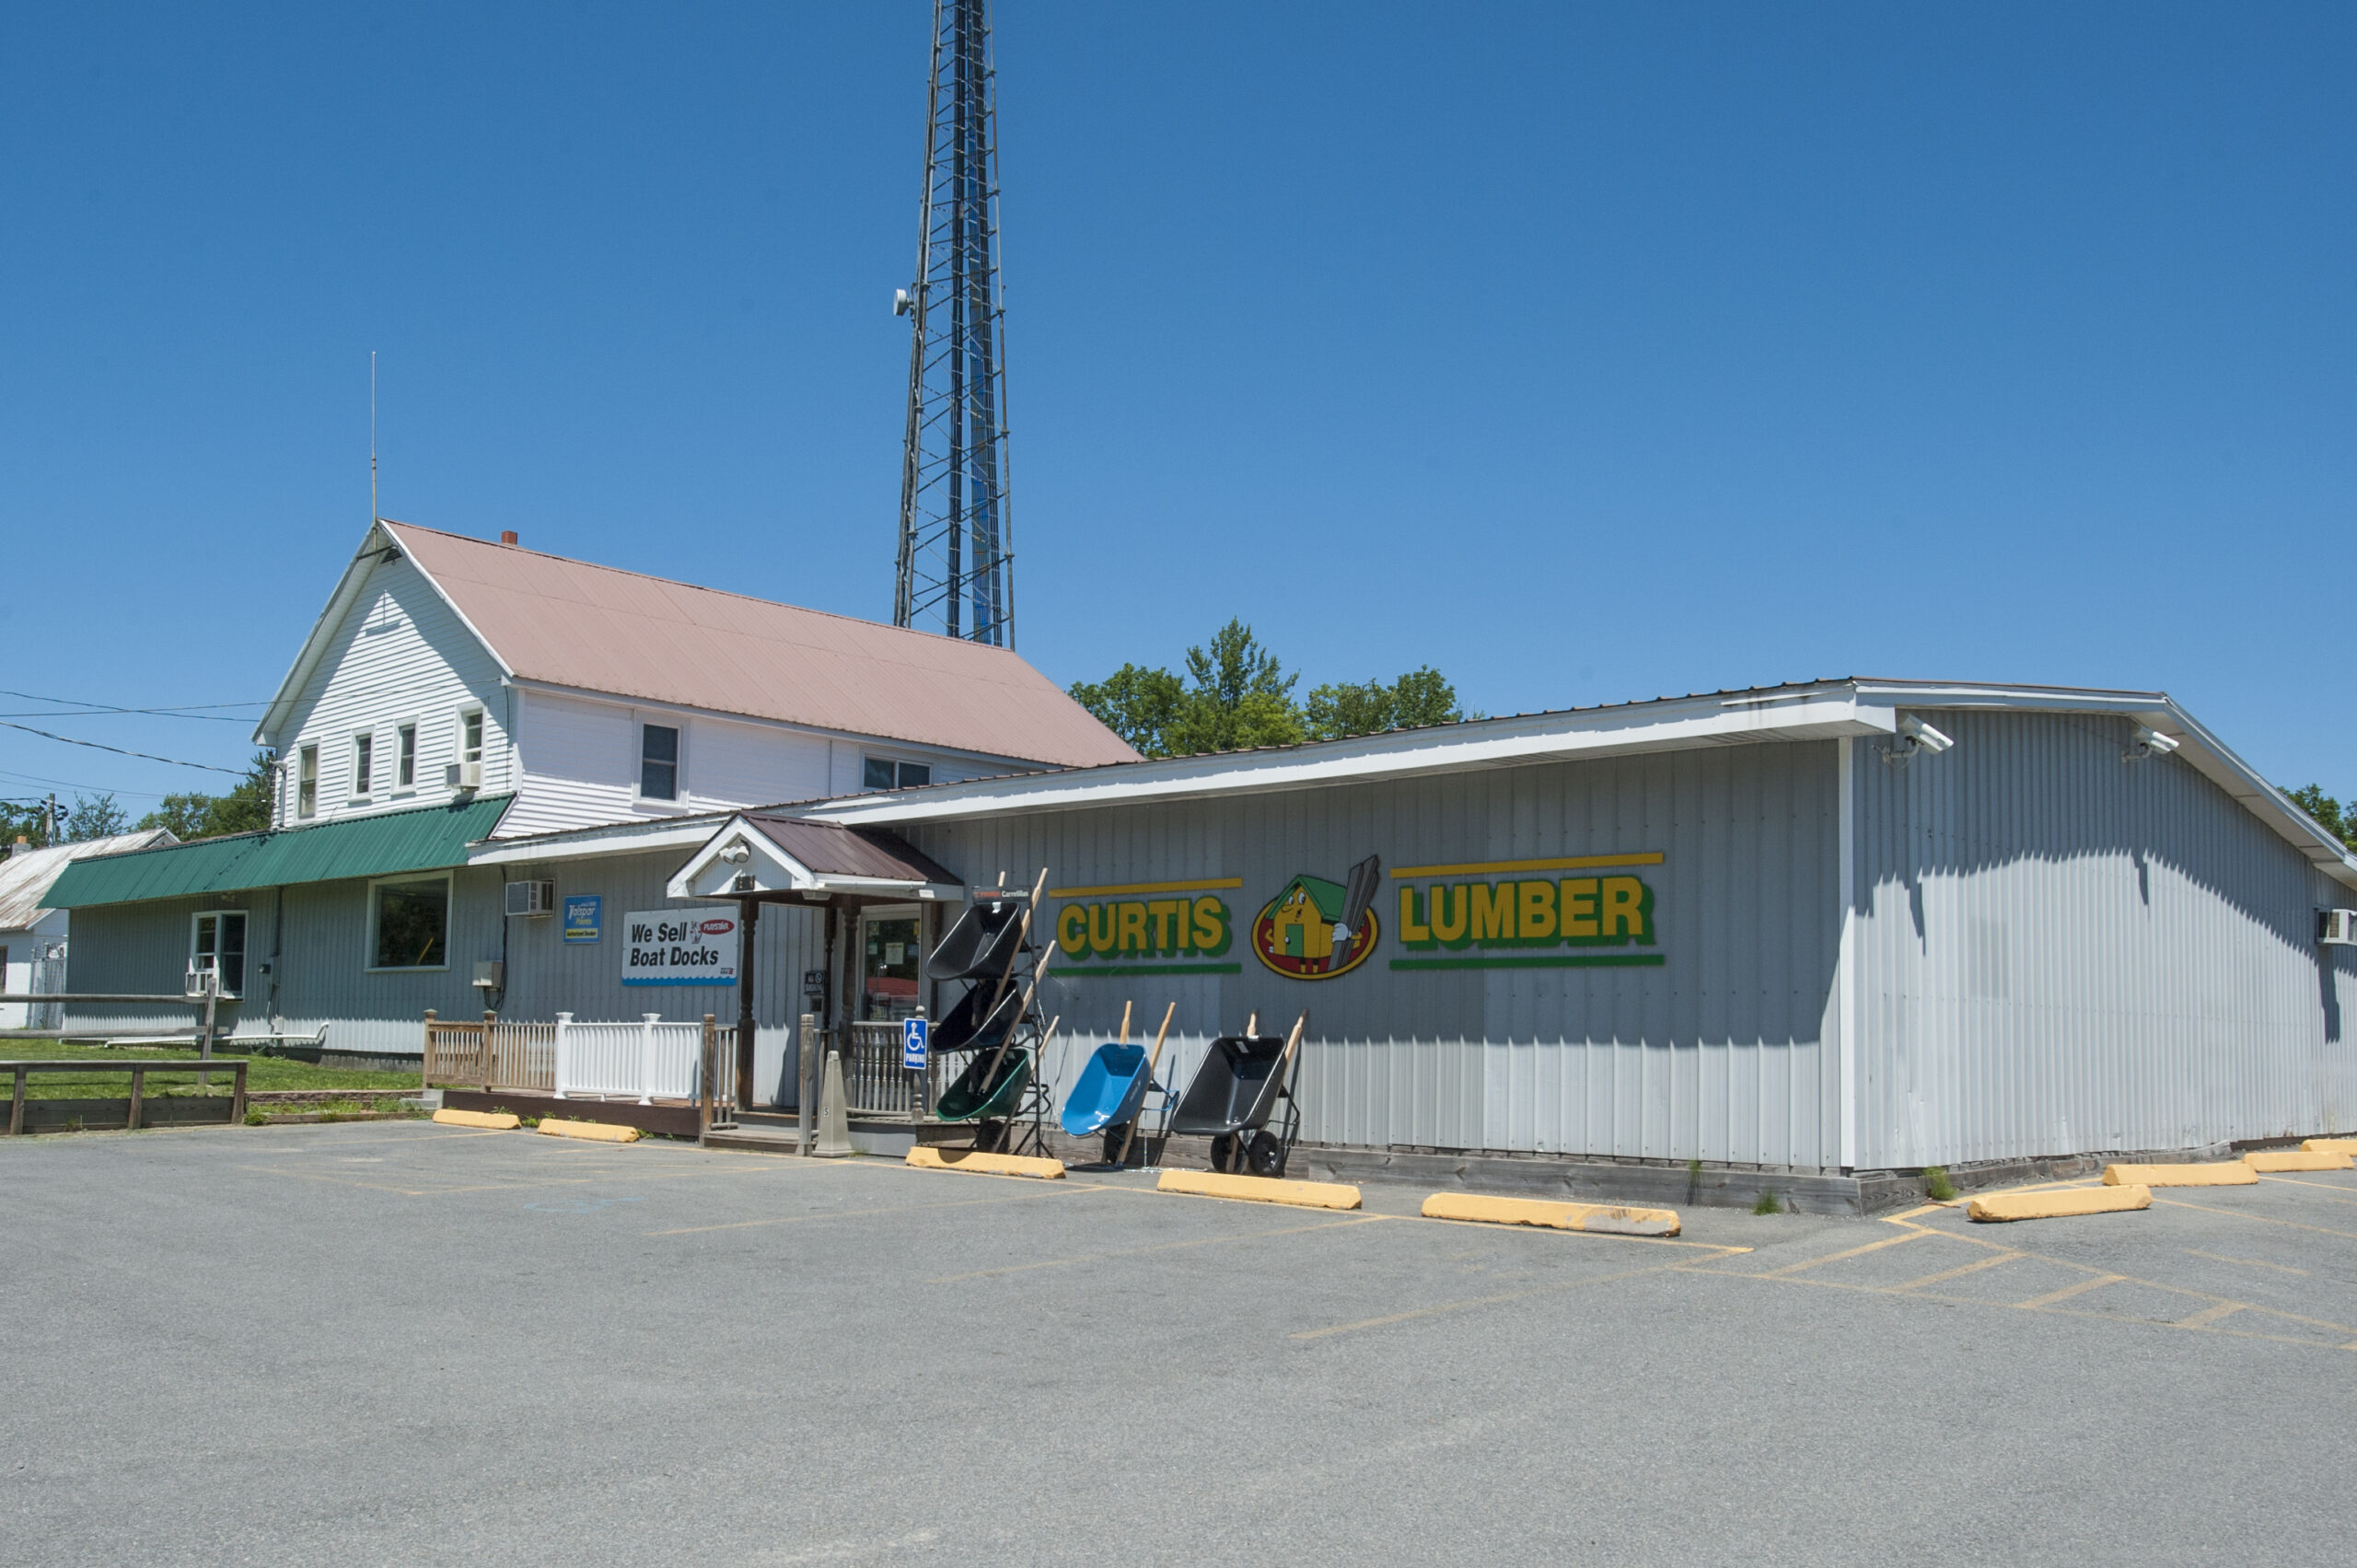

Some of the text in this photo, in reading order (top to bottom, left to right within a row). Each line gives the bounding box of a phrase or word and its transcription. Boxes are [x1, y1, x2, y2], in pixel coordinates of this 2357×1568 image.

[568, 904, 596, 920] Valspar
[1398, 876, 1656, 951] LUMBER
[632, 922, 688, 944] We Sell
[1056, 896, 1232, 959] CURTIS
[630, 946, 719, 967] Boat Docks
[905, 1052, 925, 1063] PARKING
